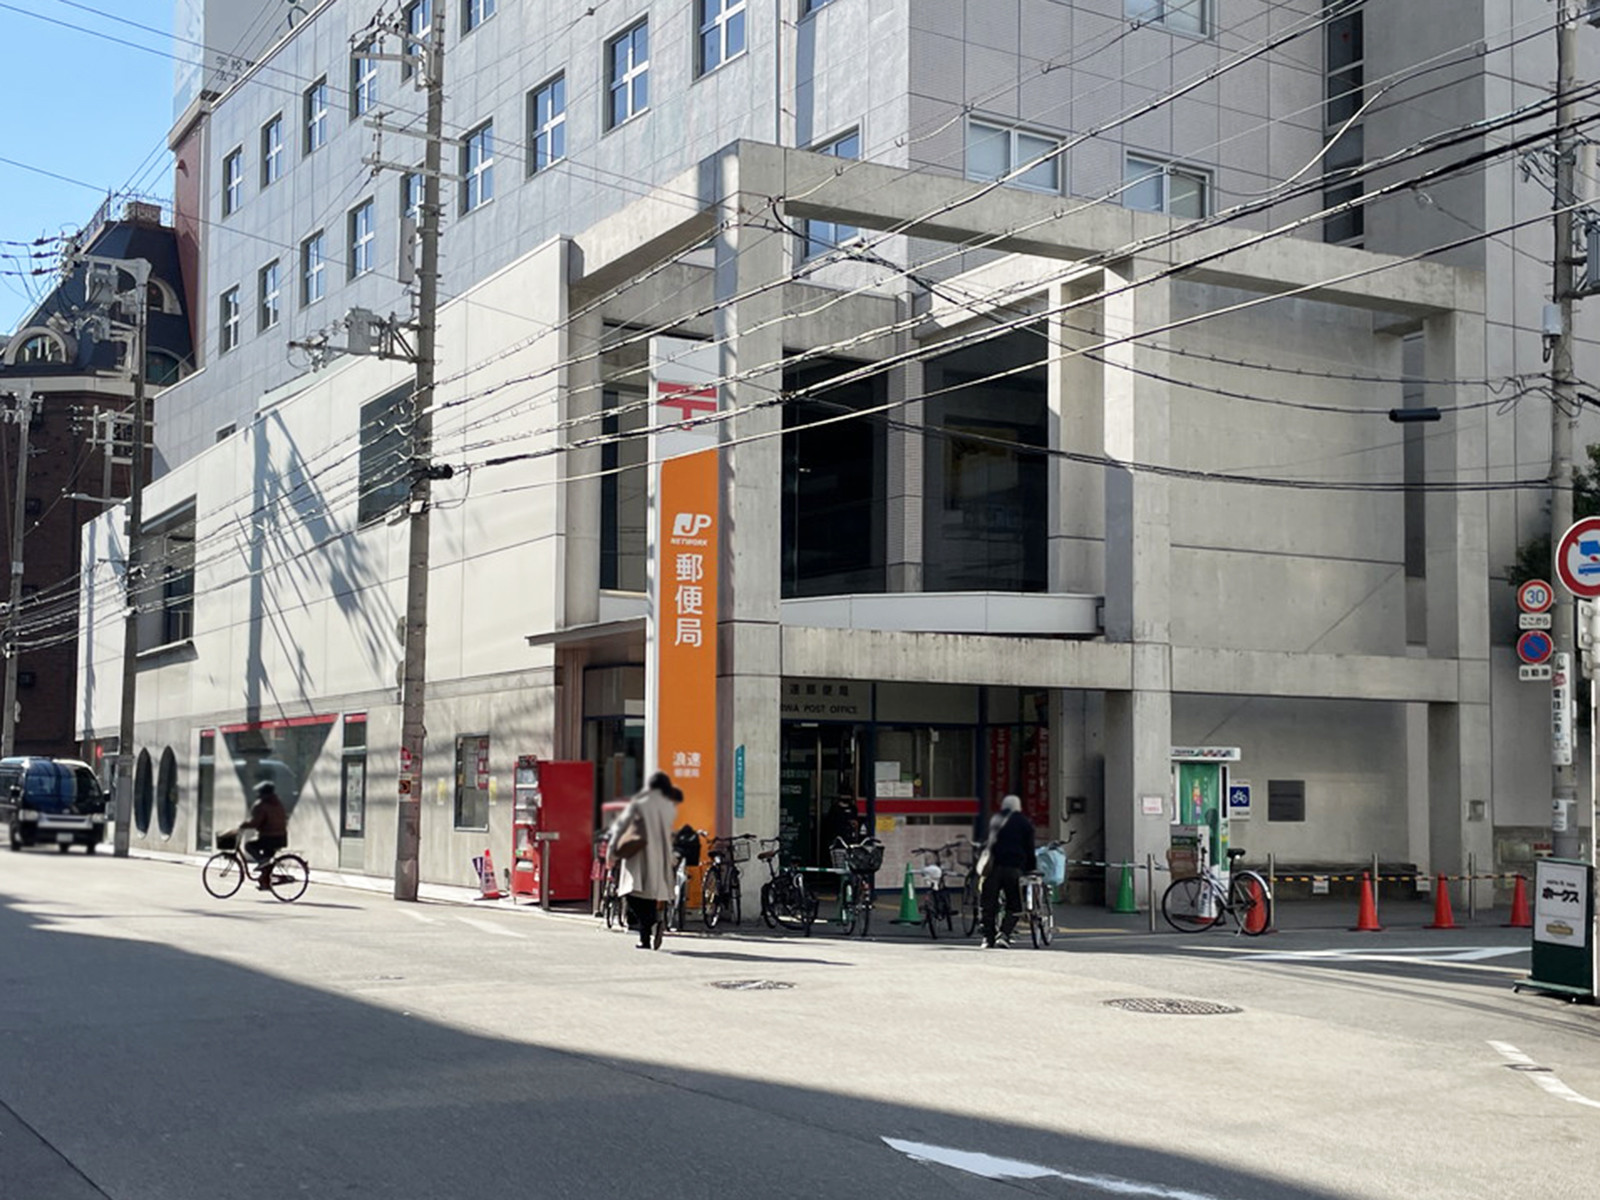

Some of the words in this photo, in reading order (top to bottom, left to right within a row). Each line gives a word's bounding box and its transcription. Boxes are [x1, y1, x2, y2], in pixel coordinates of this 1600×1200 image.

[670, 537, 708, 547] NETWORK
[675, 553, 703, 647] 郵便局
[1525, 589, 1545, 605] 30
[1520, 616, 1549, 627] ここから
[804, 704, 825, 713] POST
[829, 704, 857, 714] OFFICE
[673, 752, 701, 767] 浪速
[1542, 887, 1580, 904] ホークス
